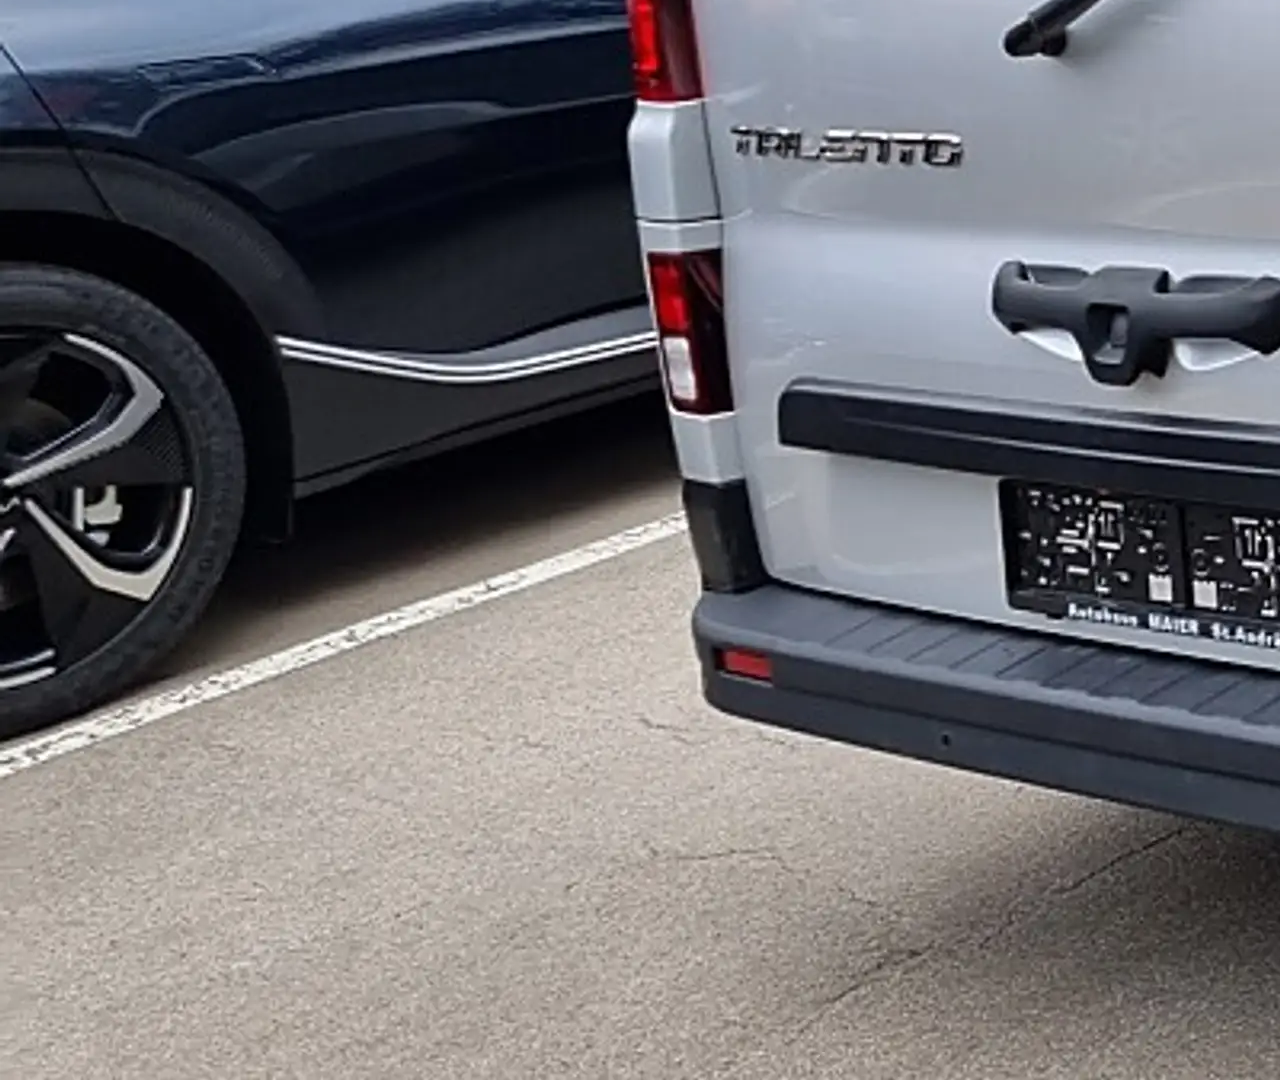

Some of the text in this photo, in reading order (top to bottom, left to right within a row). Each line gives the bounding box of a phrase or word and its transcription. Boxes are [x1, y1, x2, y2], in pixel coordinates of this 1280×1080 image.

[730, 125, 964, 166] TALENTO
[1067, 602, 1139, 628] Autohaus
[1147, 612, 1200, 636] MAIER
